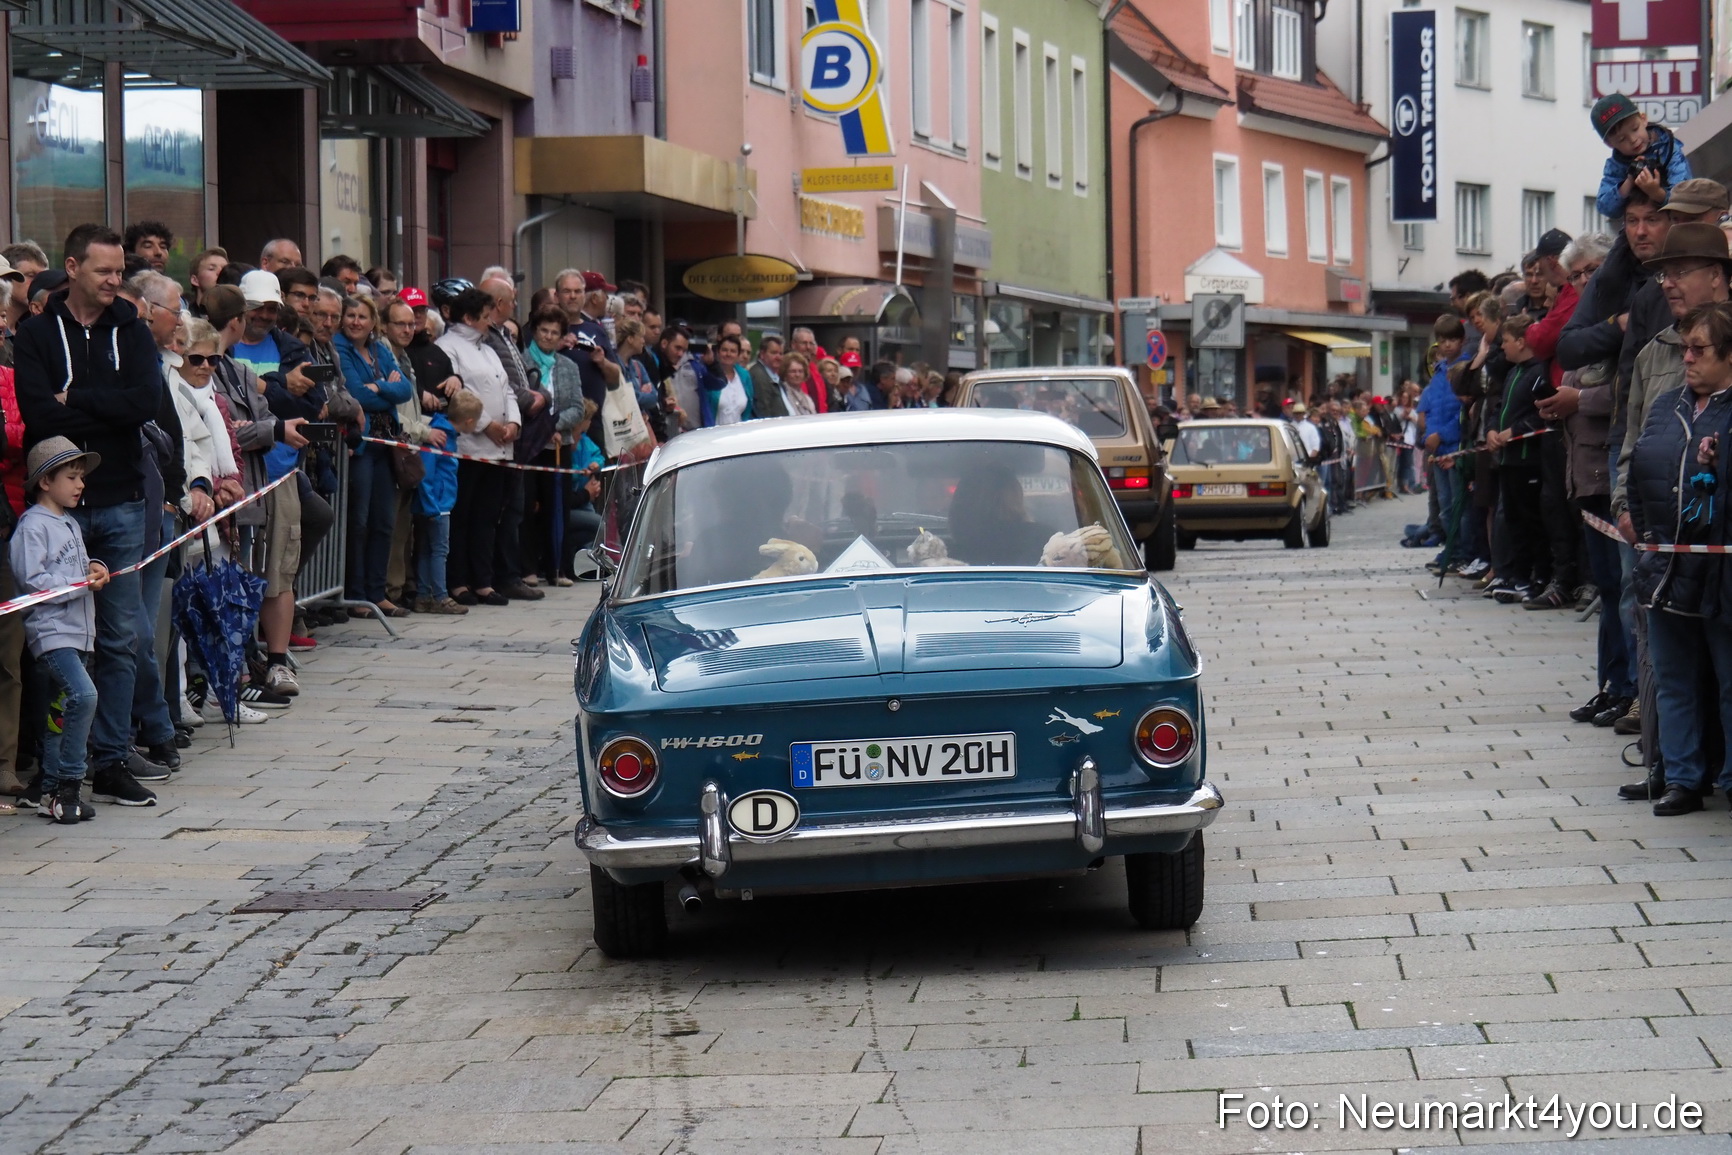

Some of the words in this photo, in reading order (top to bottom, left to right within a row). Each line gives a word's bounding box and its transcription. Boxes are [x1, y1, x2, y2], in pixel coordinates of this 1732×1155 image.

[810, 45, 852, 90] B
[1421, 27, 1433, 127] TAILOR
[1596, 61, 1697, 97] WITT
[806, 174, 879, 186] KLOSTERGASSE
[884, 173, 890, 182] 4
[688, 274, 708, 284] DIE
[709, 274, 796, 284] GOLDSCHMIEDE
[799, 770, 807, 780] D
[887, 743, 933, 778] NV
[941, 739, 1009, 775] 20H
[752, 797, 778, 831] D
